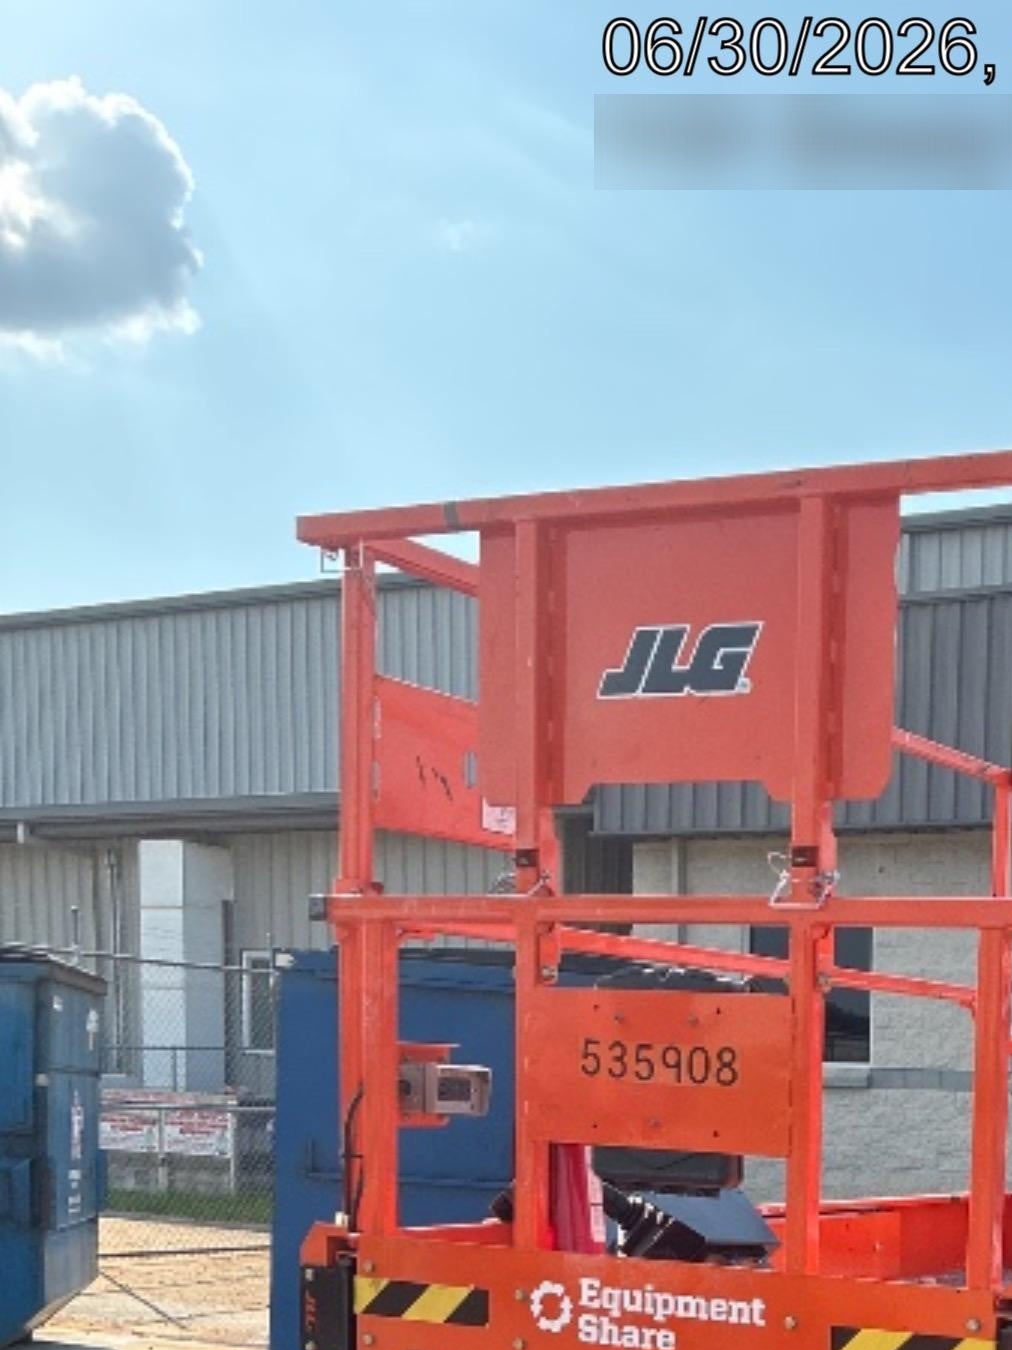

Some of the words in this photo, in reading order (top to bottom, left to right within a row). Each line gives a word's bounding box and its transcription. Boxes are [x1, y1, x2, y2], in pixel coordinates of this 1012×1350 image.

[597, 620, 764, 700] JLG
[580, 1037, 740, 1087] 535908
[578, 1276, 767, 1328] Equipment
